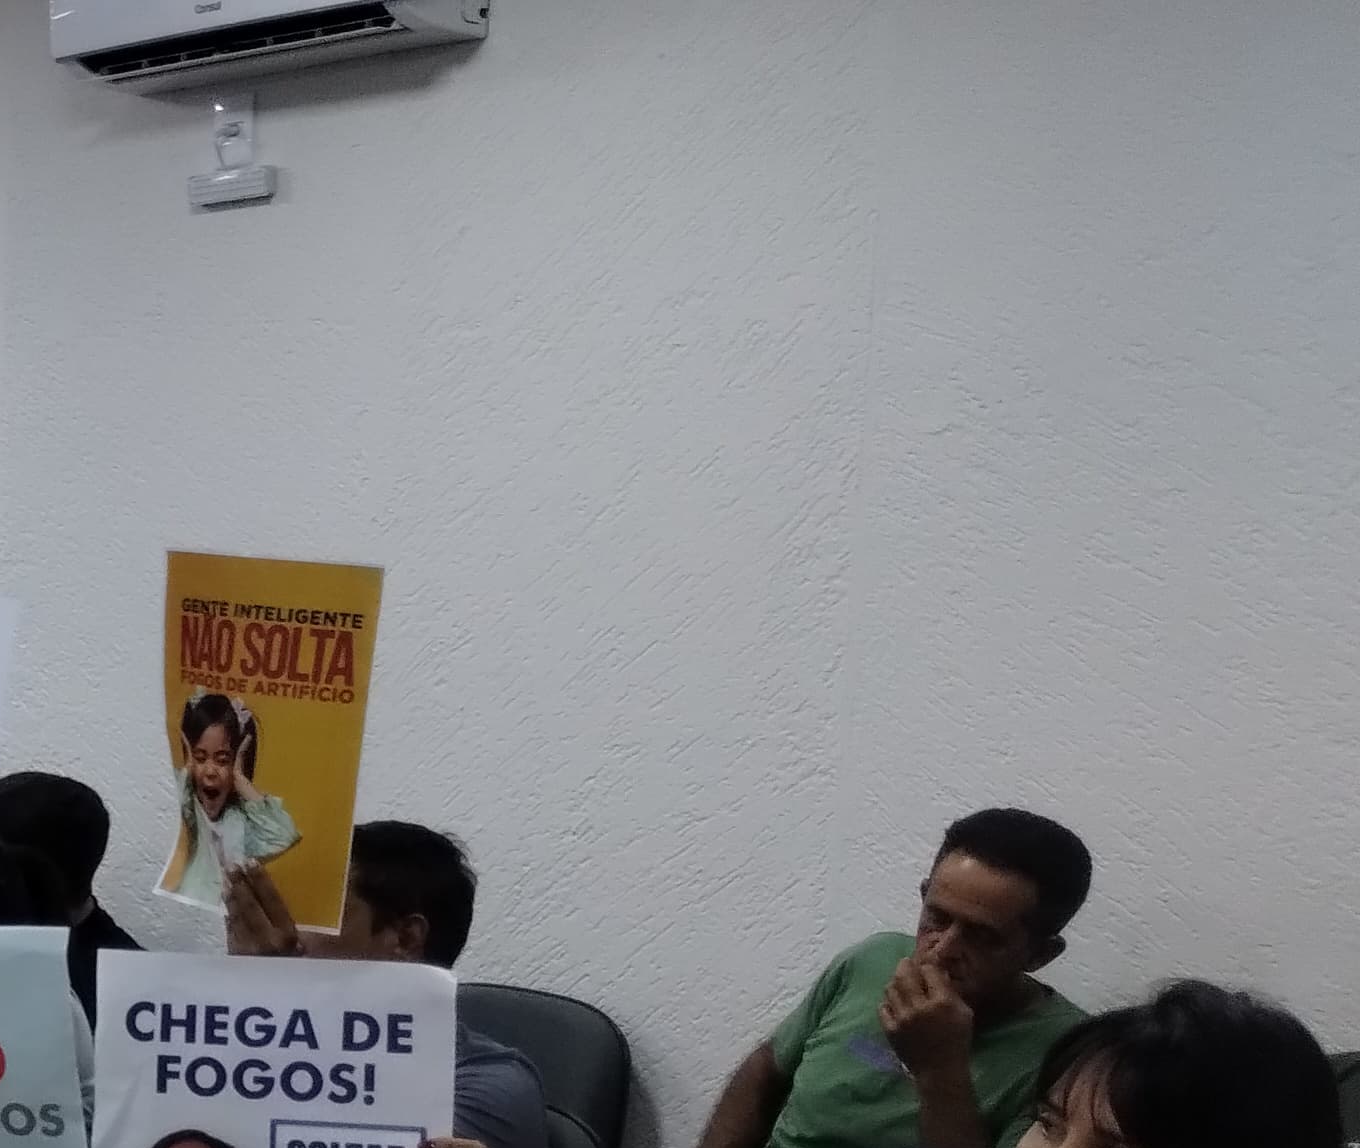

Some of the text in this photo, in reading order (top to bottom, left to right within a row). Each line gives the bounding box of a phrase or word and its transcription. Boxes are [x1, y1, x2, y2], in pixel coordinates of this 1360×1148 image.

[181, 598, 365, 630] GENTE INTELIGENTE
[180, 613, 355, 688] NÃO SOLTA
[225, 677, 248, 694] DE
[125, 1000, 414, 1055] CHEGA DE
[156, 1055, 377, 1106] FOGOS!
